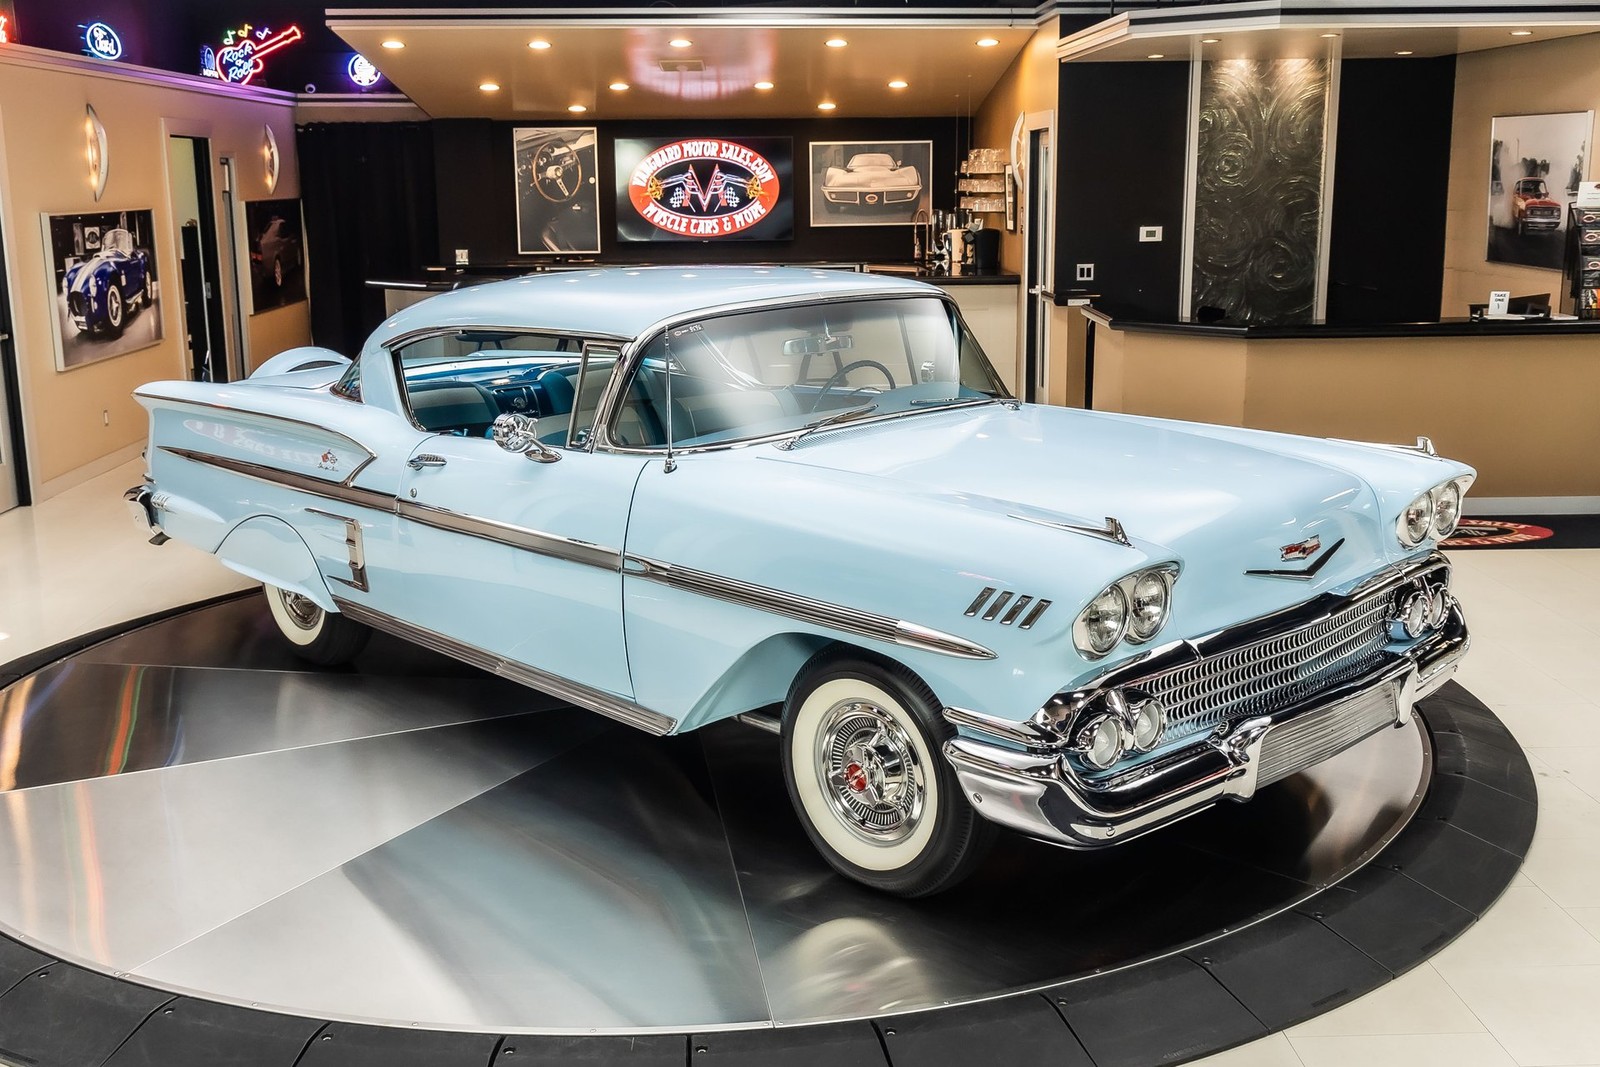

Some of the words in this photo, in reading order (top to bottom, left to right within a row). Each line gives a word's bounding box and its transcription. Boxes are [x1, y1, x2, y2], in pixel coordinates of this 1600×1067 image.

[223, 42, 253, 65] Rock
[228, 58, 254, 82] Roll
[632, 144, 682, 187] VANGUARD
[681, 141, 719, 158] MOTOR
[720, 142, 775, 184] SALES.COM
[642, 202, 688, 233] MUSCLE
[689, 217, 719, 234] CARS
[722, 216, 732, 232] &
[732, 200, 767, 229] MORE
